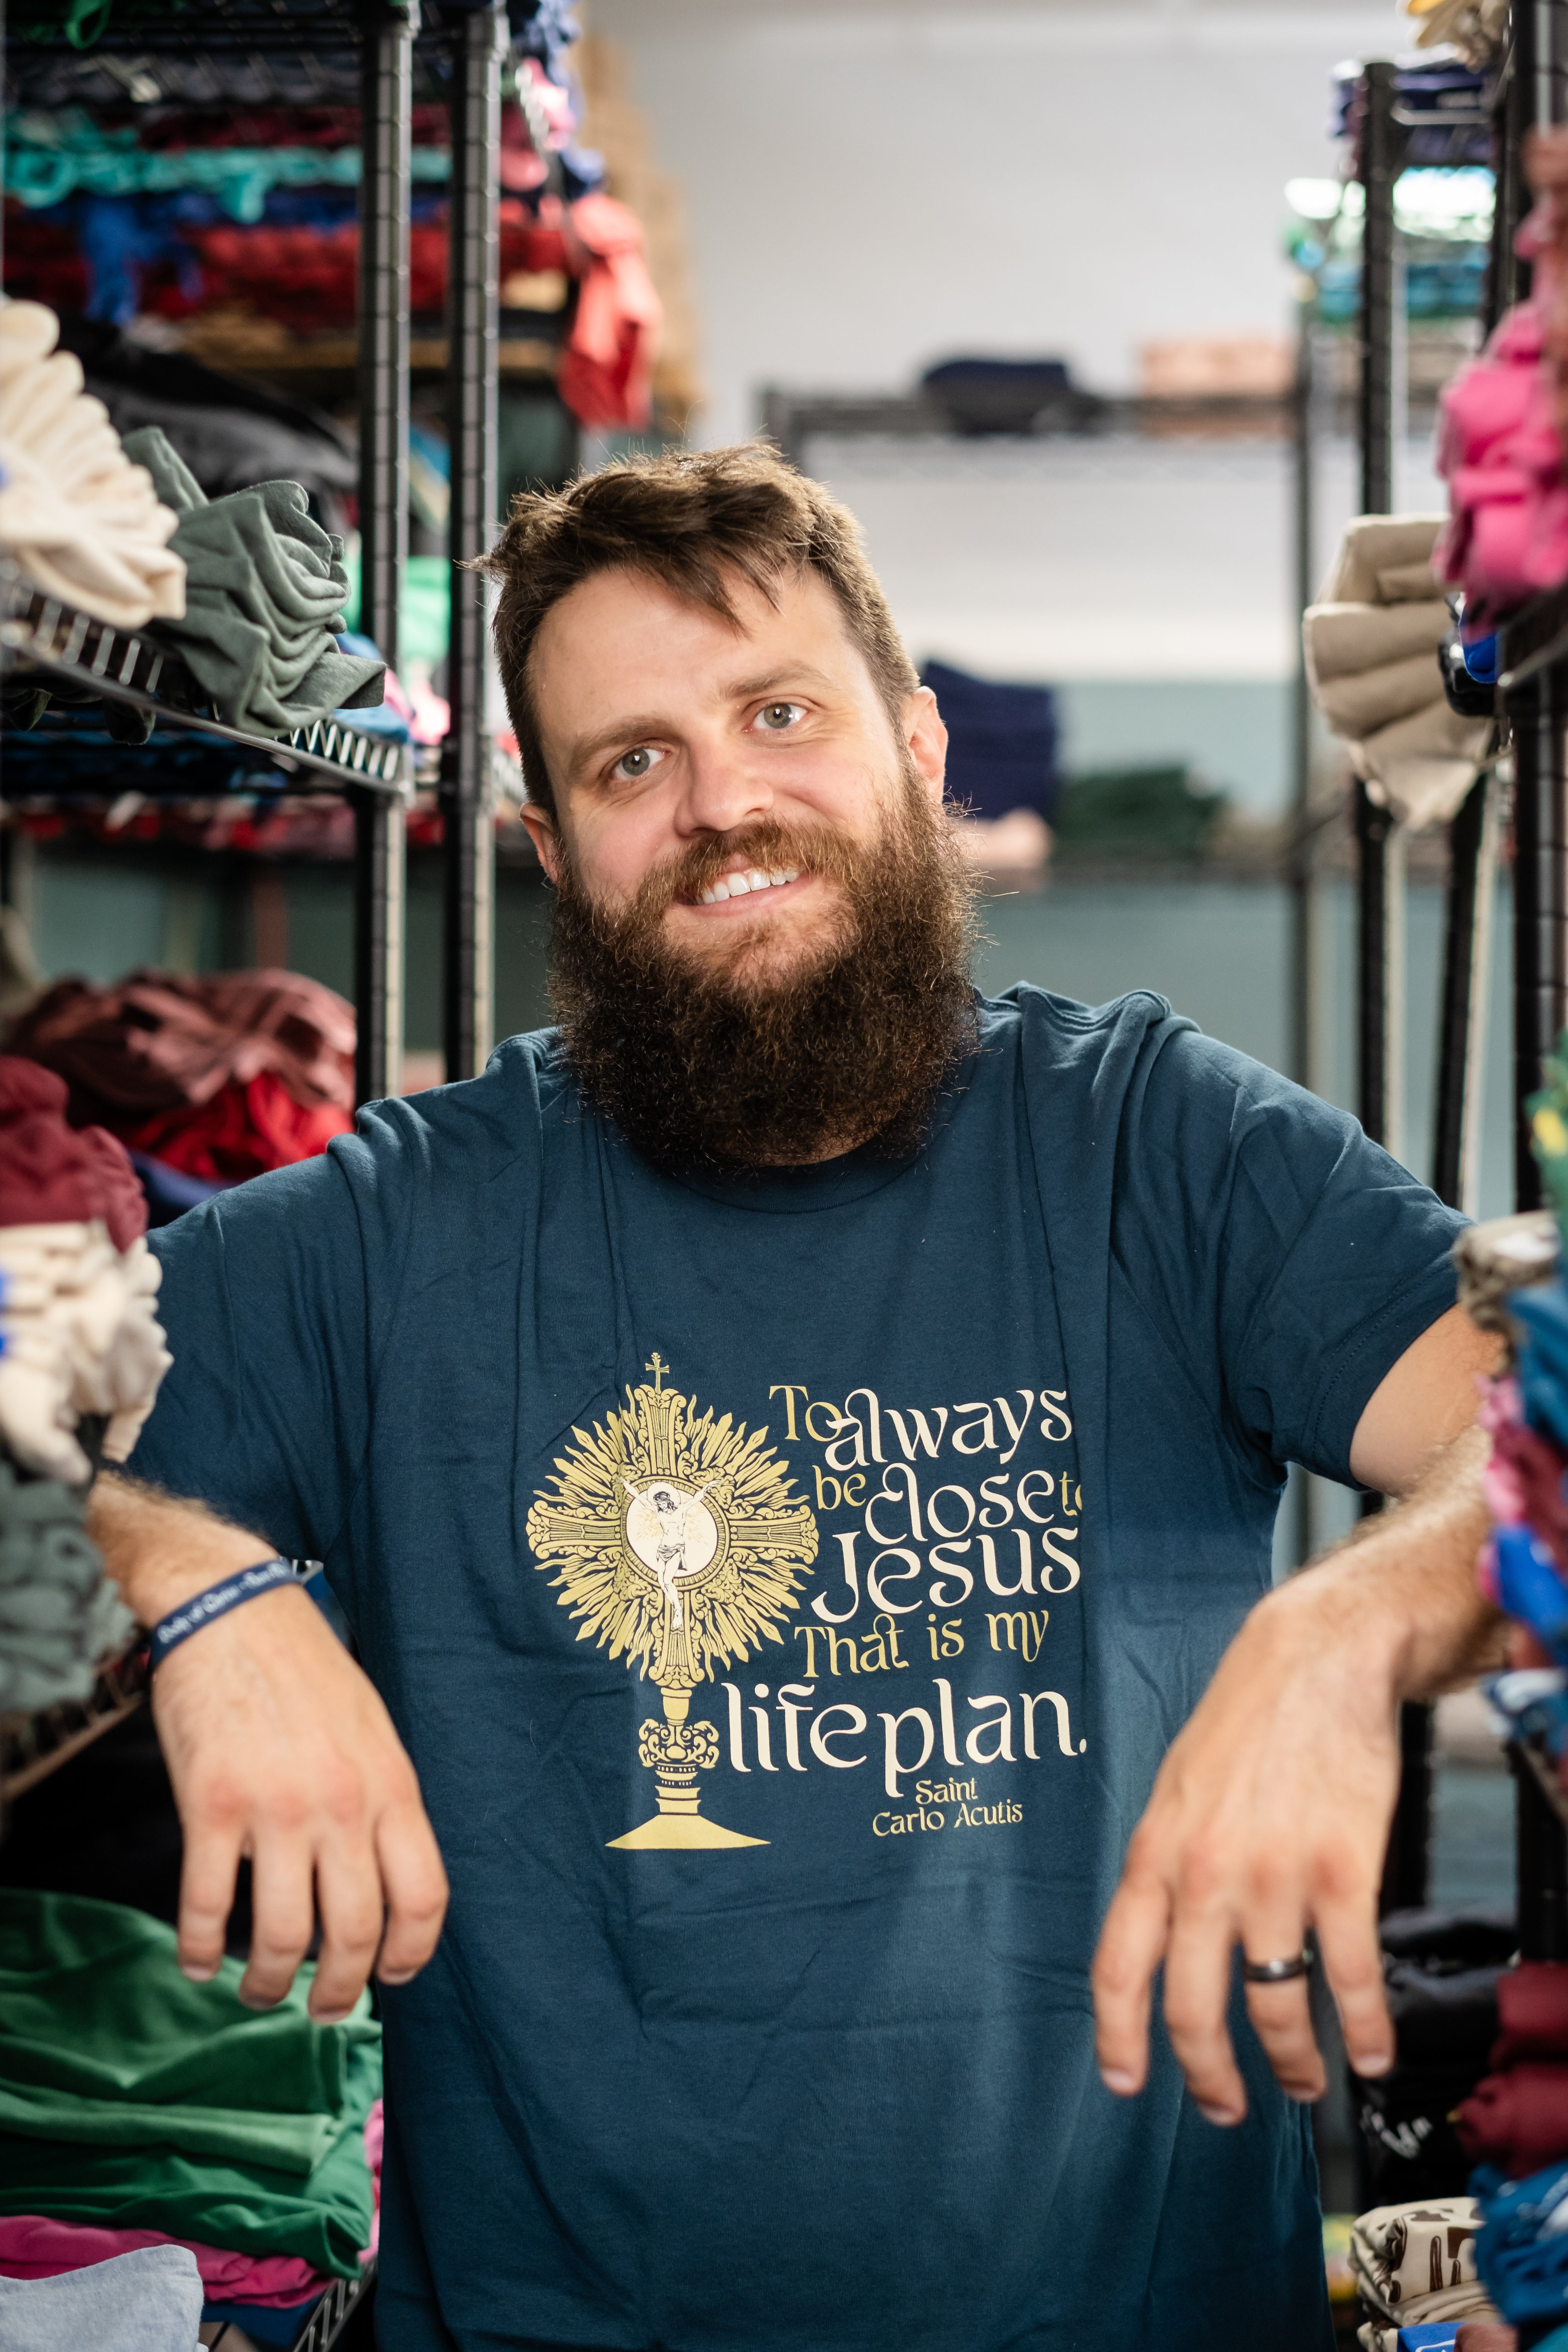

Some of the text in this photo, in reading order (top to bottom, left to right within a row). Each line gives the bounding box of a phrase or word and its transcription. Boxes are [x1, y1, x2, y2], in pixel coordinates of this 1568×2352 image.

[769, 1385, 1072, 1471] To always
[812, 1465, 866, 1510] be
[865, 1463, 1054, 1545] close
[810, 1527, 1080, 1624] Jesus
[794, 1610, 1049, 1678] That is my
[721, 1678, 1087, 1798] life plan.
[872, 1799, 1023, 1836] Carlo Acutis
[915, 1777, 978, 1805] Saint
